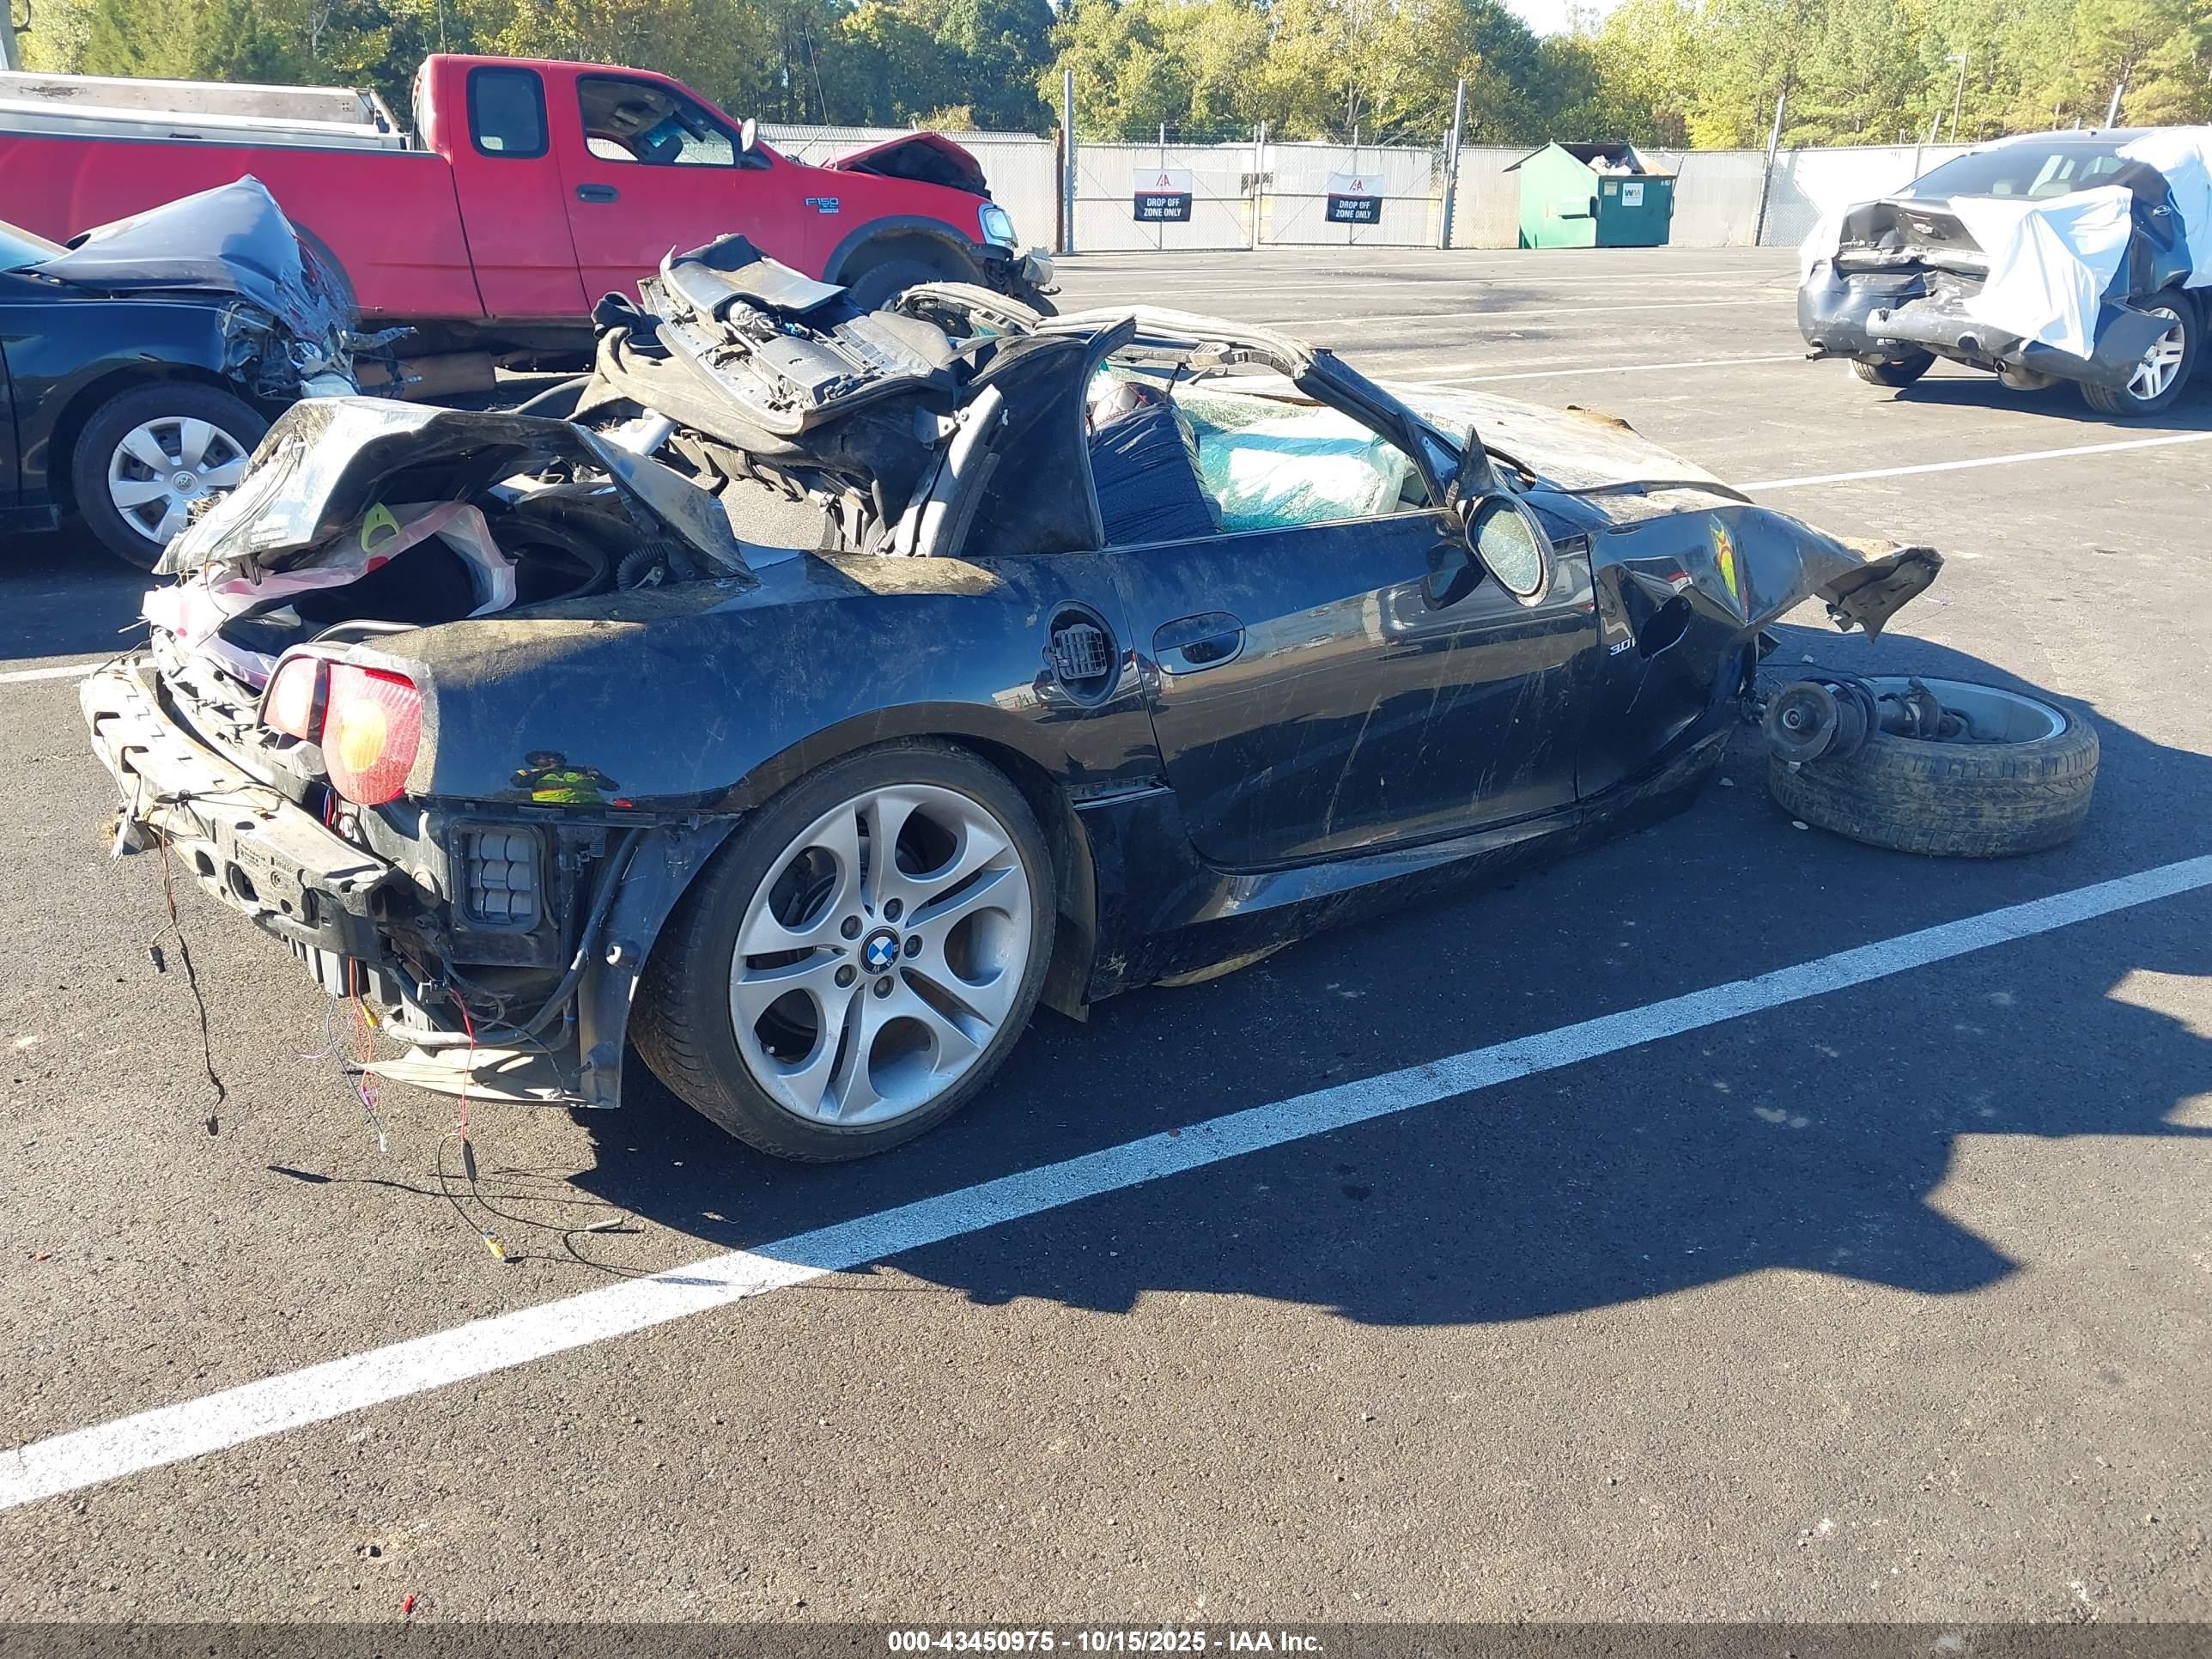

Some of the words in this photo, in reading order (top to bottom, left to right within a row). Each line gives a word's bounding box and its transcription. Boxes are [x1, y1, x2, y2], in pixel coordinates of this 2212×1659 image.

[1146, 198, 1166, 207] DROP
[1167, 198, 1181, 207] OFF
[1339, 200, 1358, 210] DROP
[1358, 201, 1370, 210] OFF
[1143, 207, 1163, 217] ZONE
[1164, 207, 1182, 217] ONLY
[1335, 209, 1354, 218] ZONE
[1354, 210, 1372, 219] ONLY
